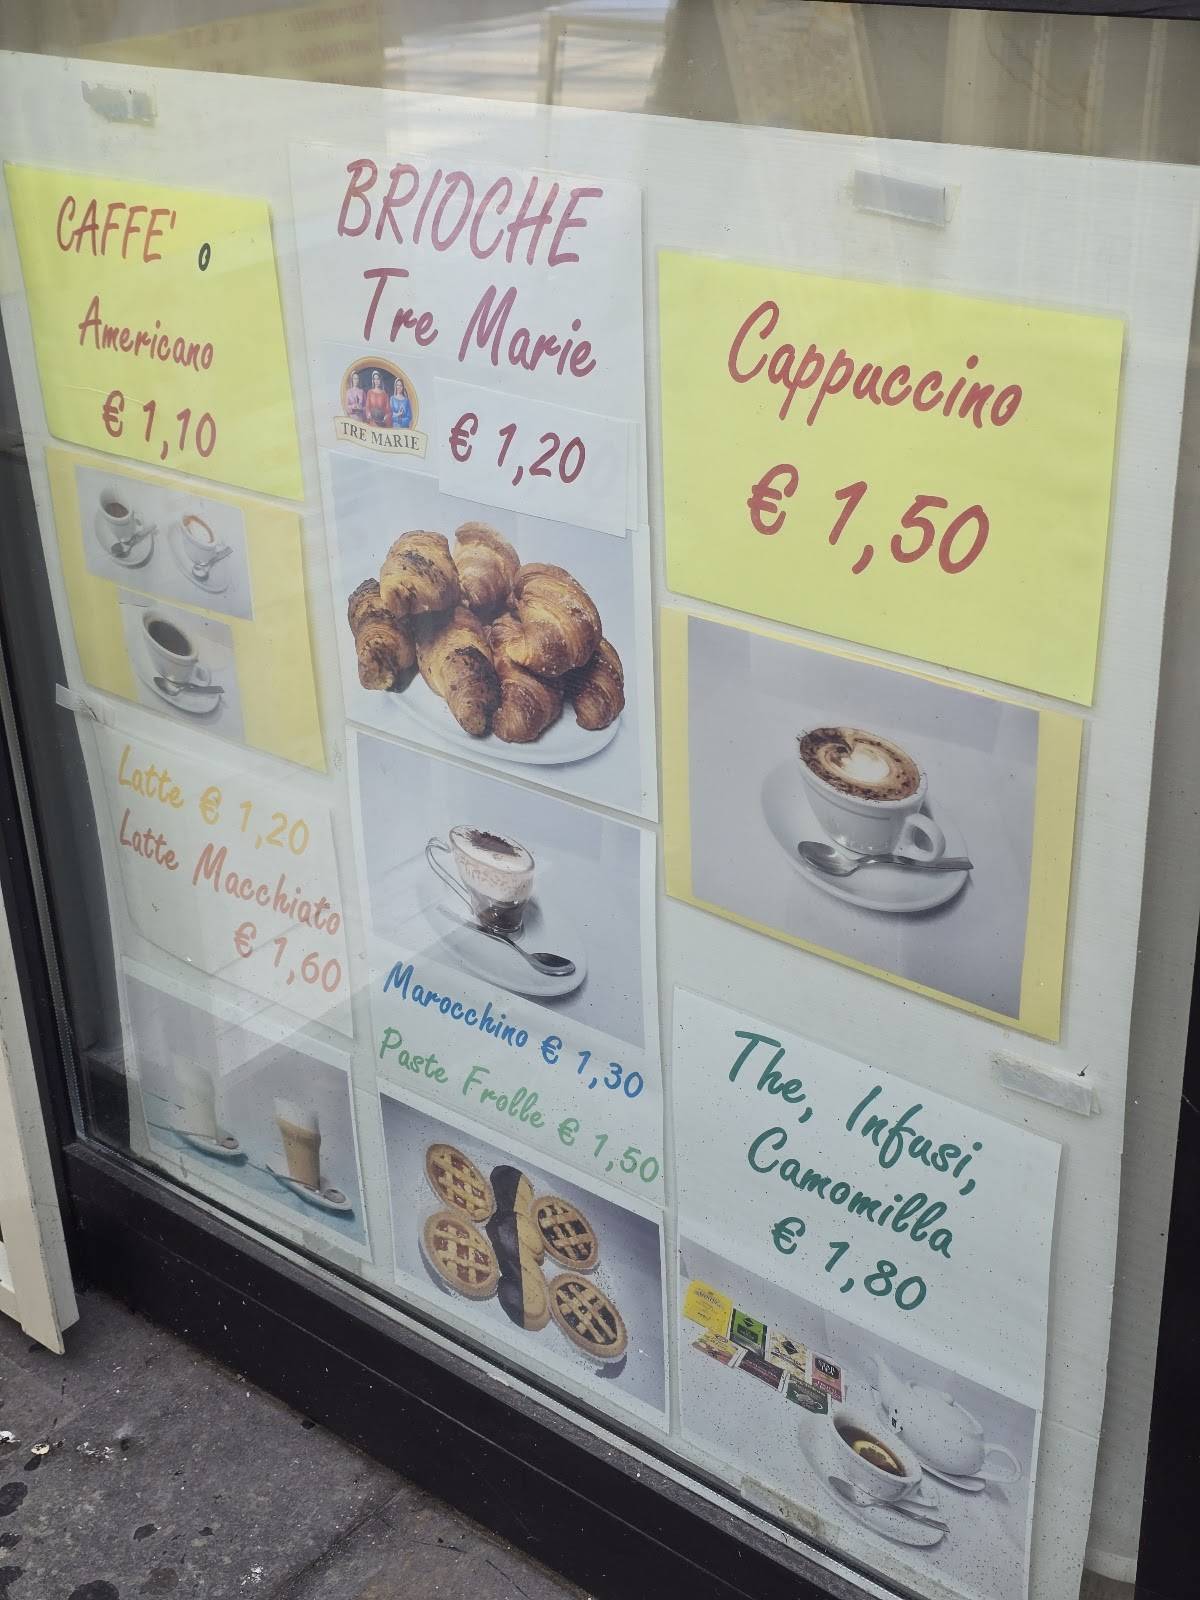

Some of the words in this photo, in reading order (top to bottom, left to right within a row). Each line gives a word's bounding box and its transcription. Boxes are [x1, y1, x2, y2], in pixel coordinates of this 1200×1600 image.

[56, 195, 176, 263] CAFFE'
[337, 158, 604, 267] BRIOCHE
[79, 295, 214, 371] Americano
[363, 267, 439, 347] Tre
[458, 285, 597, 378] Marie
[728, 300, 1023, 429] Cappuccino
[102, 390, 125, 438] €
[143, 400, 217, 460] 1,10
[341, 422, 367, 441] TRE
[371, 431, 419, 450] MARIE
[449, 412, 479, 462] €
[497, 423, 586, 486] 1,20
[747, 463, 799, 535] €
[828, 481, 990, 575] 1,50
[118, 745, 184, 808] Latte
[199, 786, 224, 825] €
[239, 799, 309, 855] 1,20
[119, 808, 179, 871] Latte
[192, 843, 341, 936] Macchiato
[233, 921, 258, 959] €
[272, 935, 342, 993] 1,60
[383, 960, 529, 1050] Marocchino
[540, 1035, 562, 1064] €
[577, 1050, 644, 1099] 1,30
[379, 1026, 448, 1085] Paste
[462, 1065, 546, 1130] Frolle
[557, 1118, 581, 1146] €
[593, 1133, 661, 1184] 1,50
[728, 1029, 814, 1124] The,
[845, 1085, 984, 1196] Infusi,
[748, 1126, 952, 1259] Camomilla
[771, 1216, 806, 1255] €
[823, 1241, 927, 1311] 1,80
